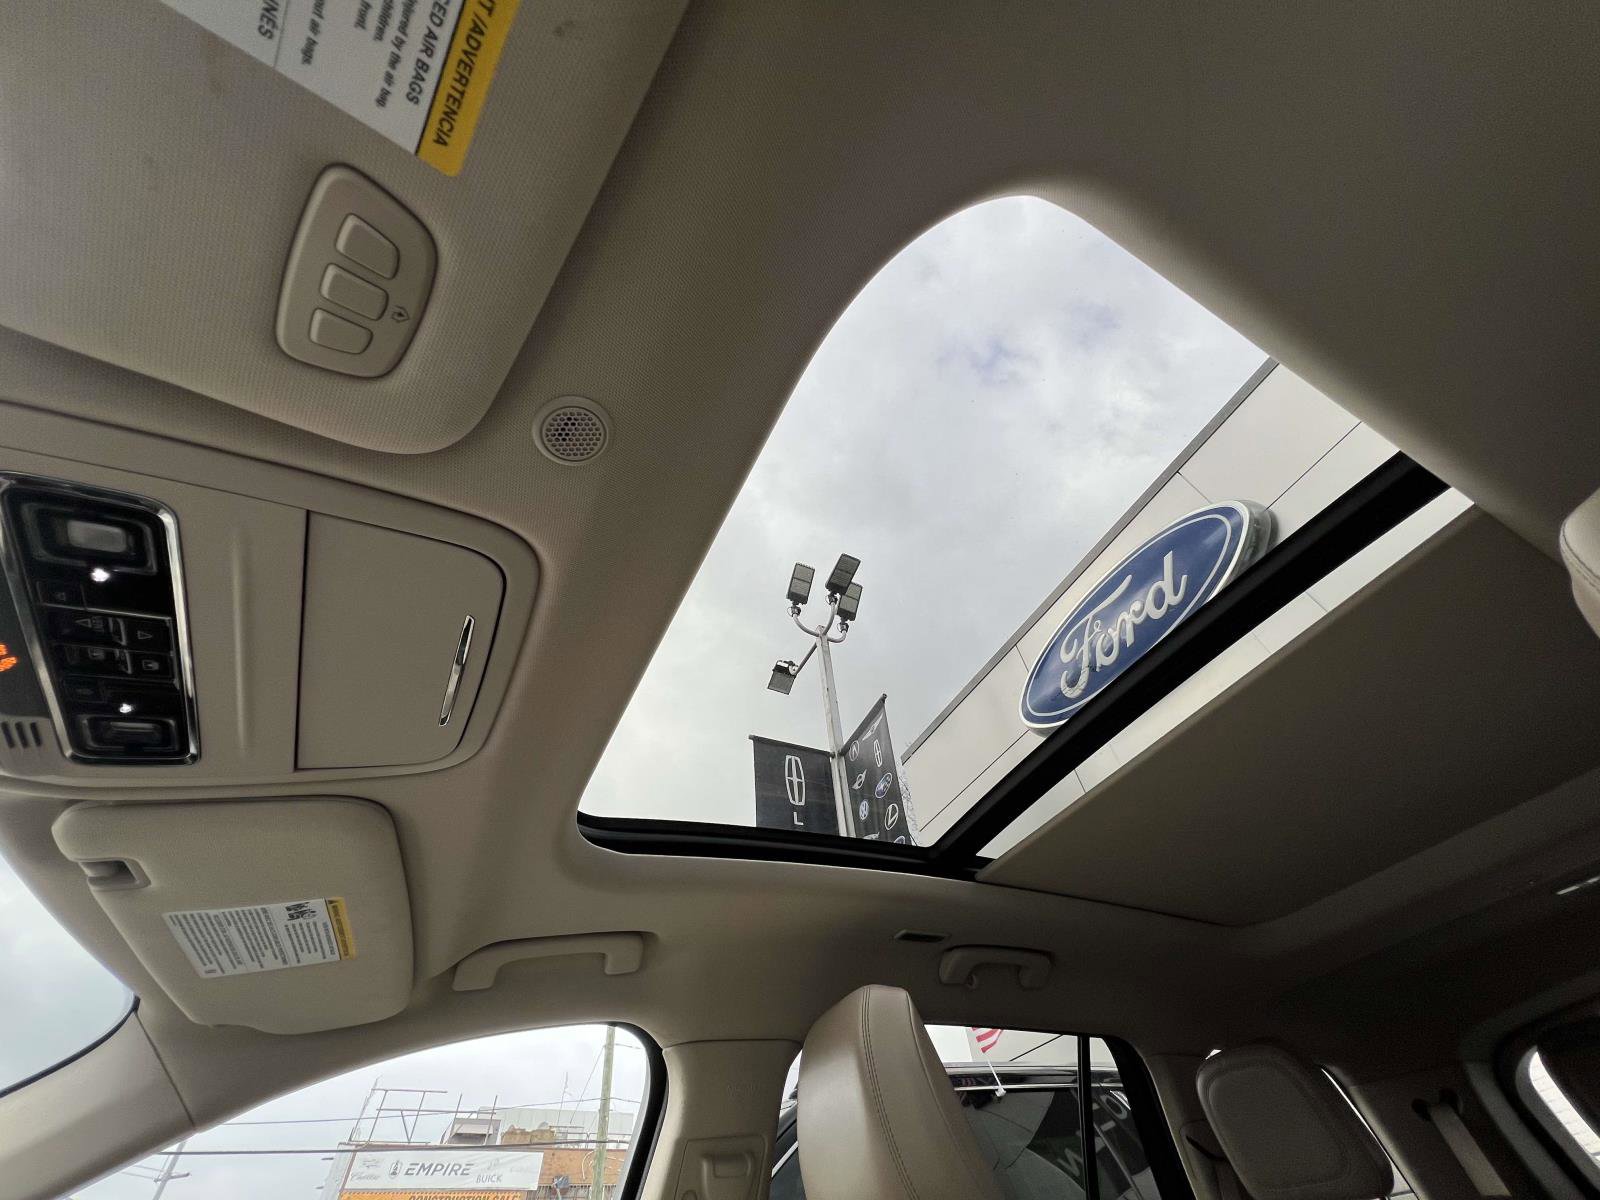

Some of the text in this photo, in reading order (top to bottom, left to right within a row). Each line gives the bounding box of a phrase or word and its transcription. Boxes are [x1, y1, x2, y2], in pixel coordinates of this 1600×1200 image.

[420, 25, 438, 58] AIR
[406, 57, 430, 105] BAGS
[1059, 550, 1188, 699] Ford
[404, 1162, 474, 1177] EMPIRE
[476, 1173, 503, 1184] BUICK
